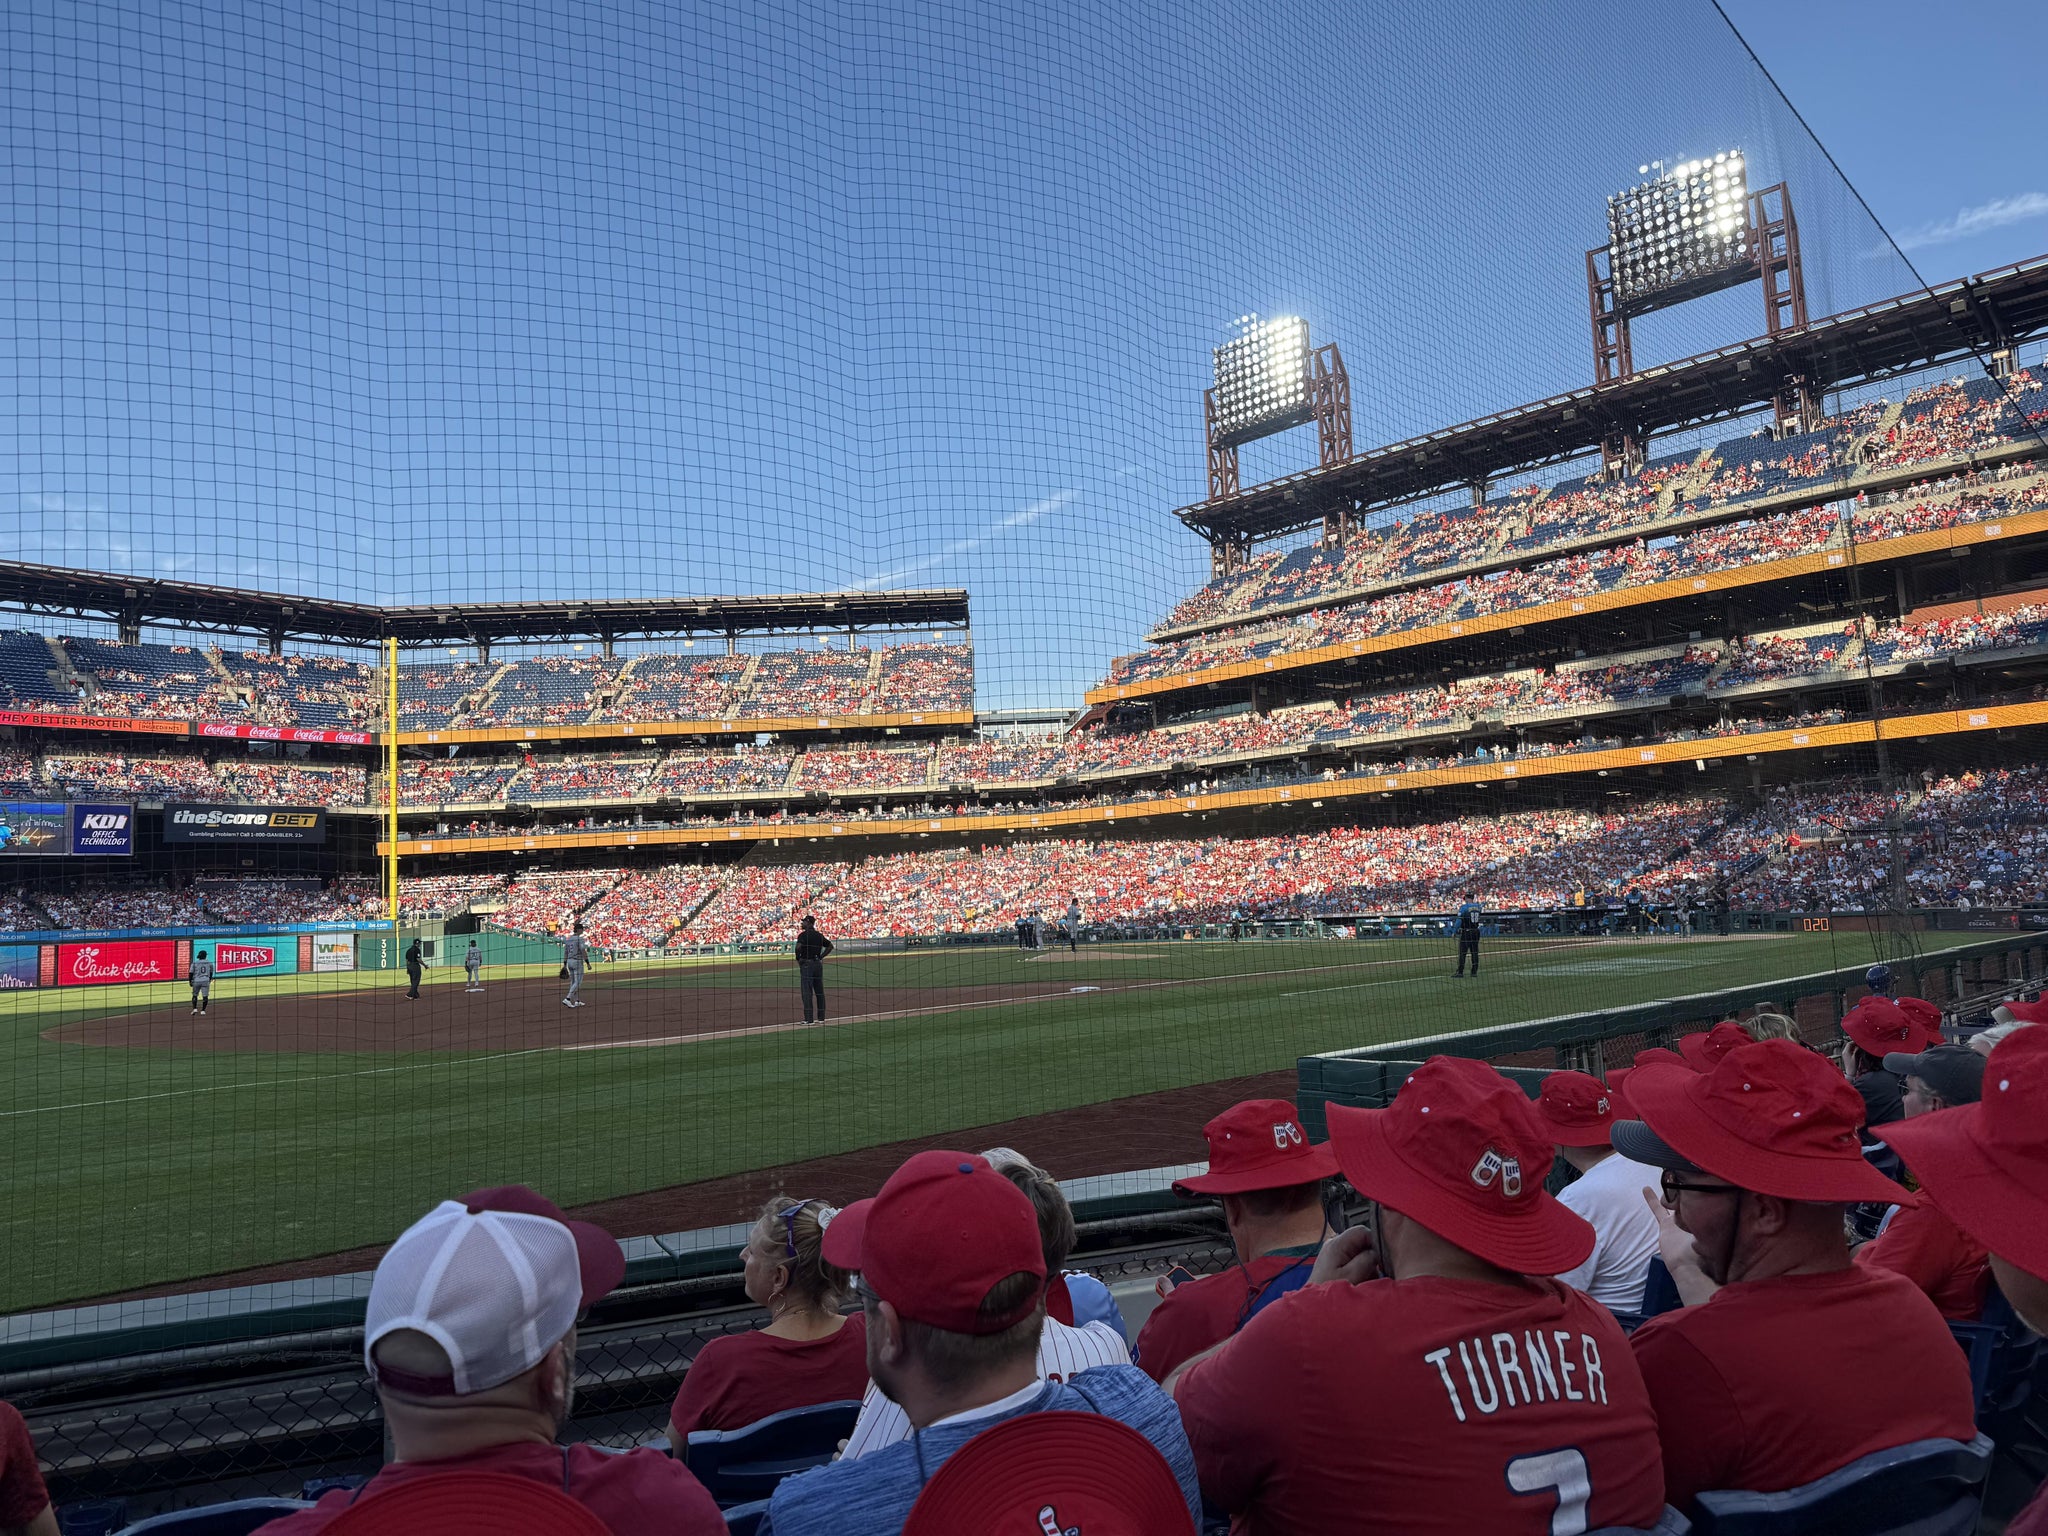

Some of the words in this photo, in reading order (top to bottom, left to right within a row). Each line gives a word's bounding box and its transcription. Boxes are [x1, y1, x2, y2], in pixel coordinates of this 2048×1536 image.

[0, 714, 28, 722] HEY
[33, 715, 78, 726] BETTER
[81, 718, 132, 729] PROTEIN
[82, 814, 128, 829] KDI
[173, 810, 268, 825] theScore
[273, 815, 314, 825] BET
[80, 837, 128, 846] TECHNOLOGY
[92, 830, 117, 838] OFFICE
[73, 947, 160, 979] Chick-fil-A
[221, 949, 268, 965] HERR'S
[1424, 1329, 1608, 1422] TURNER
